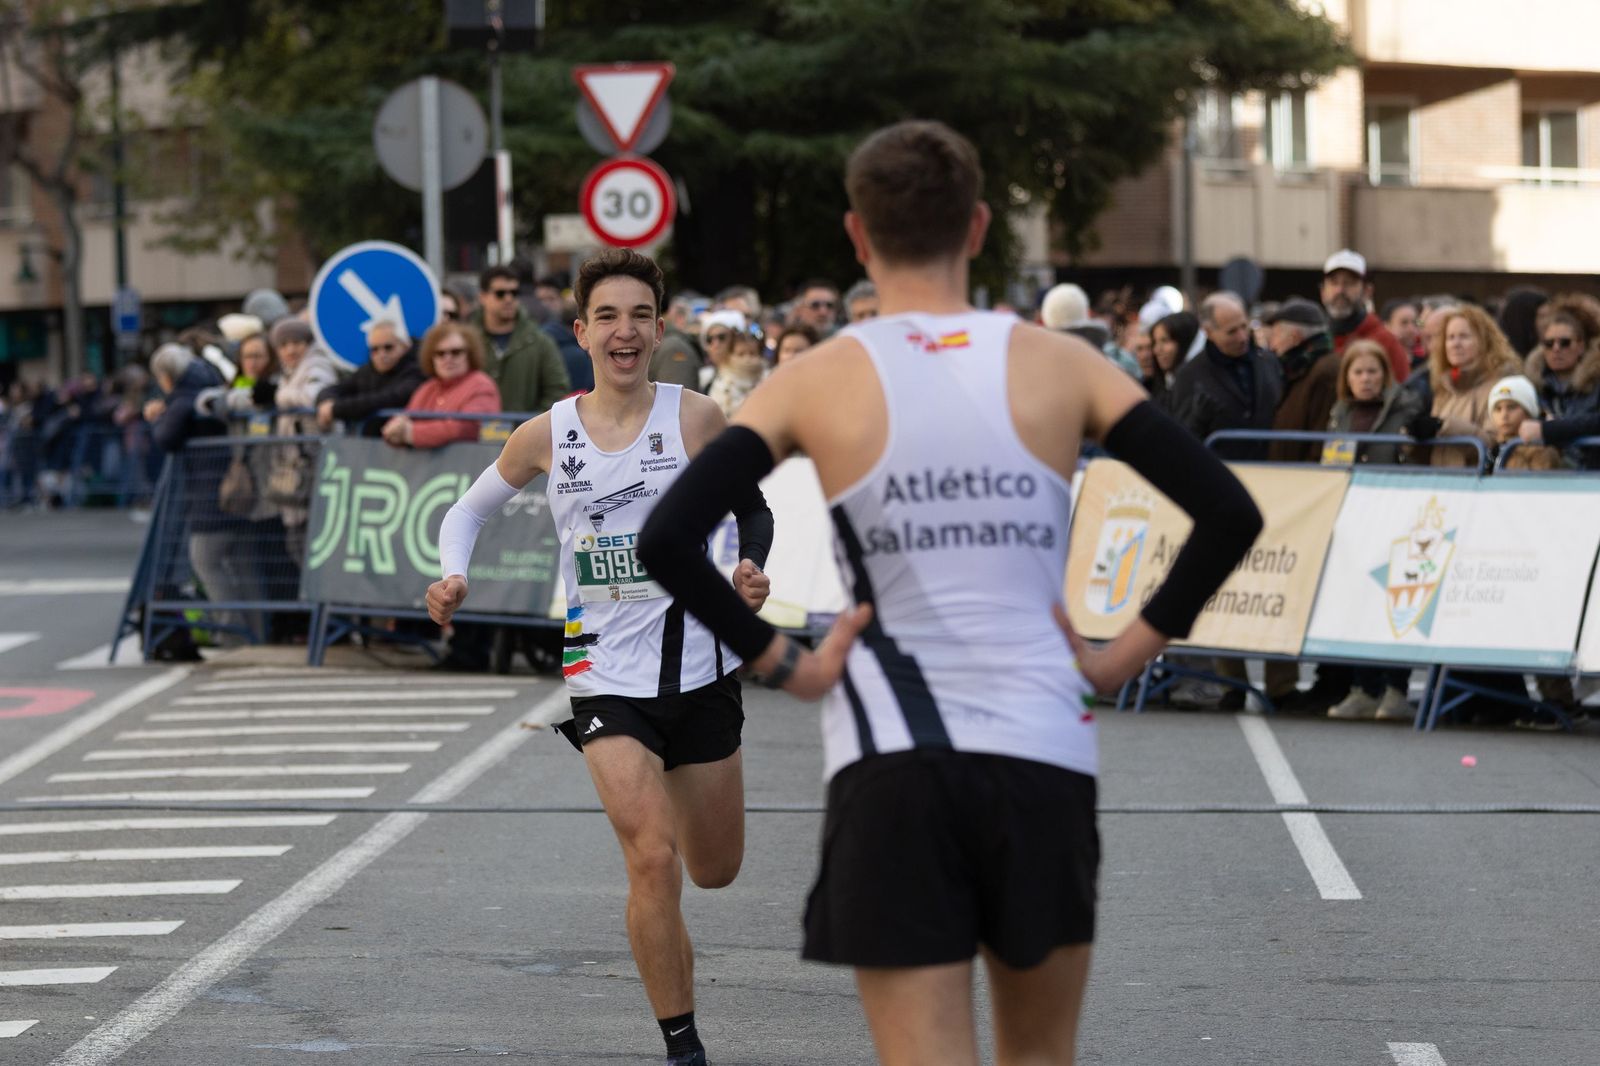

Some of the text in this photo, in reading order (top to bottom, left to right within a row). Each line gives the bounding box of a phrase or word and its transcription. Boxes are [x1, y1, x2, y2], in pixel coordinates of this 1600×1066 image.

[603, 188, 651, 219] 30
[640, 456, 677, 466] Ayuntamiento
[648, 463, 678, 472] Salamanca
[571, 480, 593, 488] RURAL
[883, 466, 1037, 504] Atlético
[597, 532, 641, 548] SET
[589, 549, 648, 579] 6198
[1204, 590, 1286, 617] amanca
